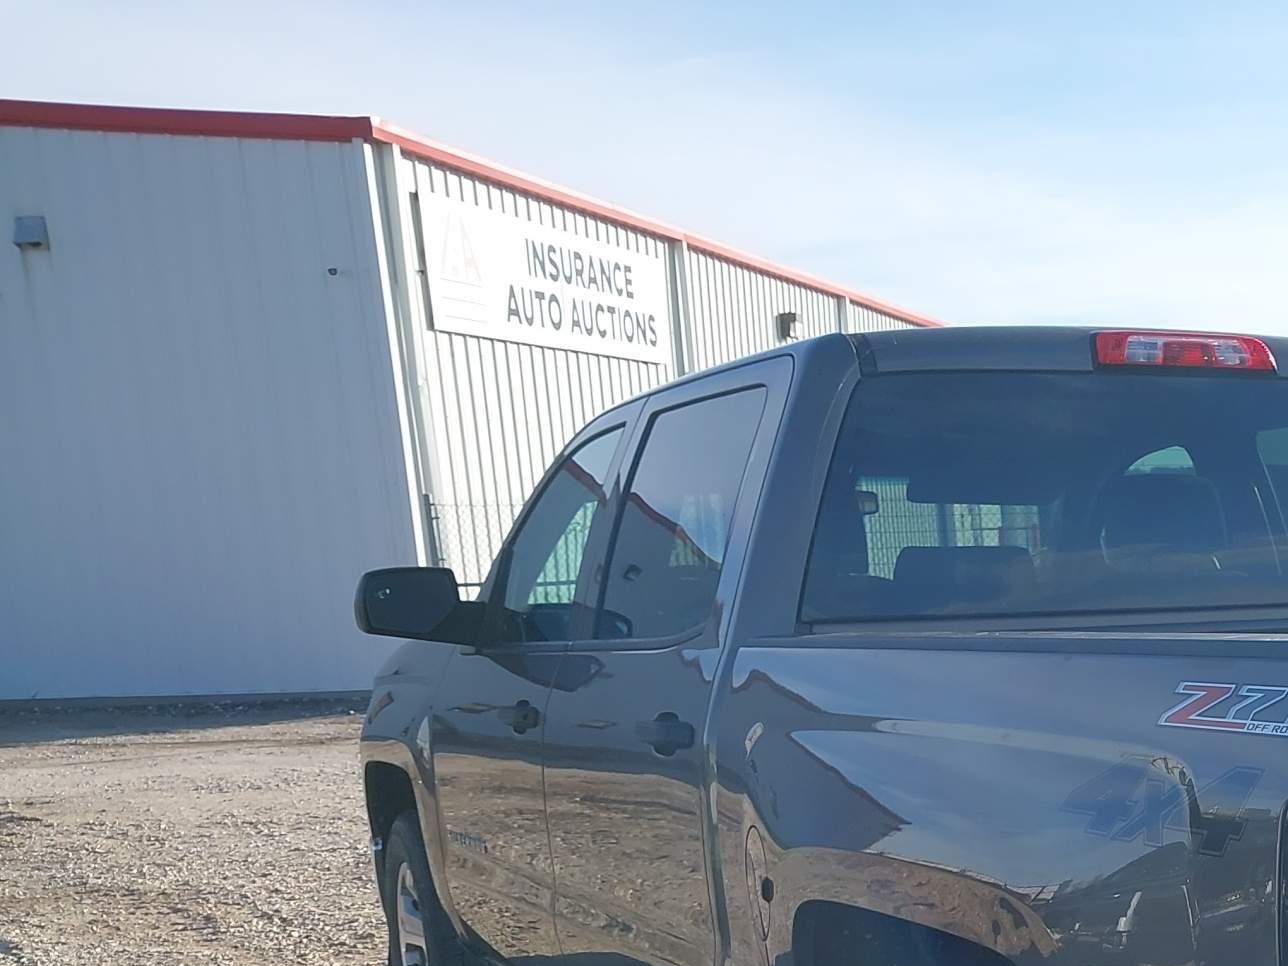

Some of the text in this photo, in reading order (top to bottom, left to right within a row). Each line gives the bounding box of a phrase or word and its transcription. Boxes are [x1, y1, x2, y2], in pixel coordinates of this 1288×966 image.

[525, 238, 634, 299] INSURANCE
[506, 284, 658, 347] AUTO AUCTIONS
[1247, 724, 1271, 732] OFF
